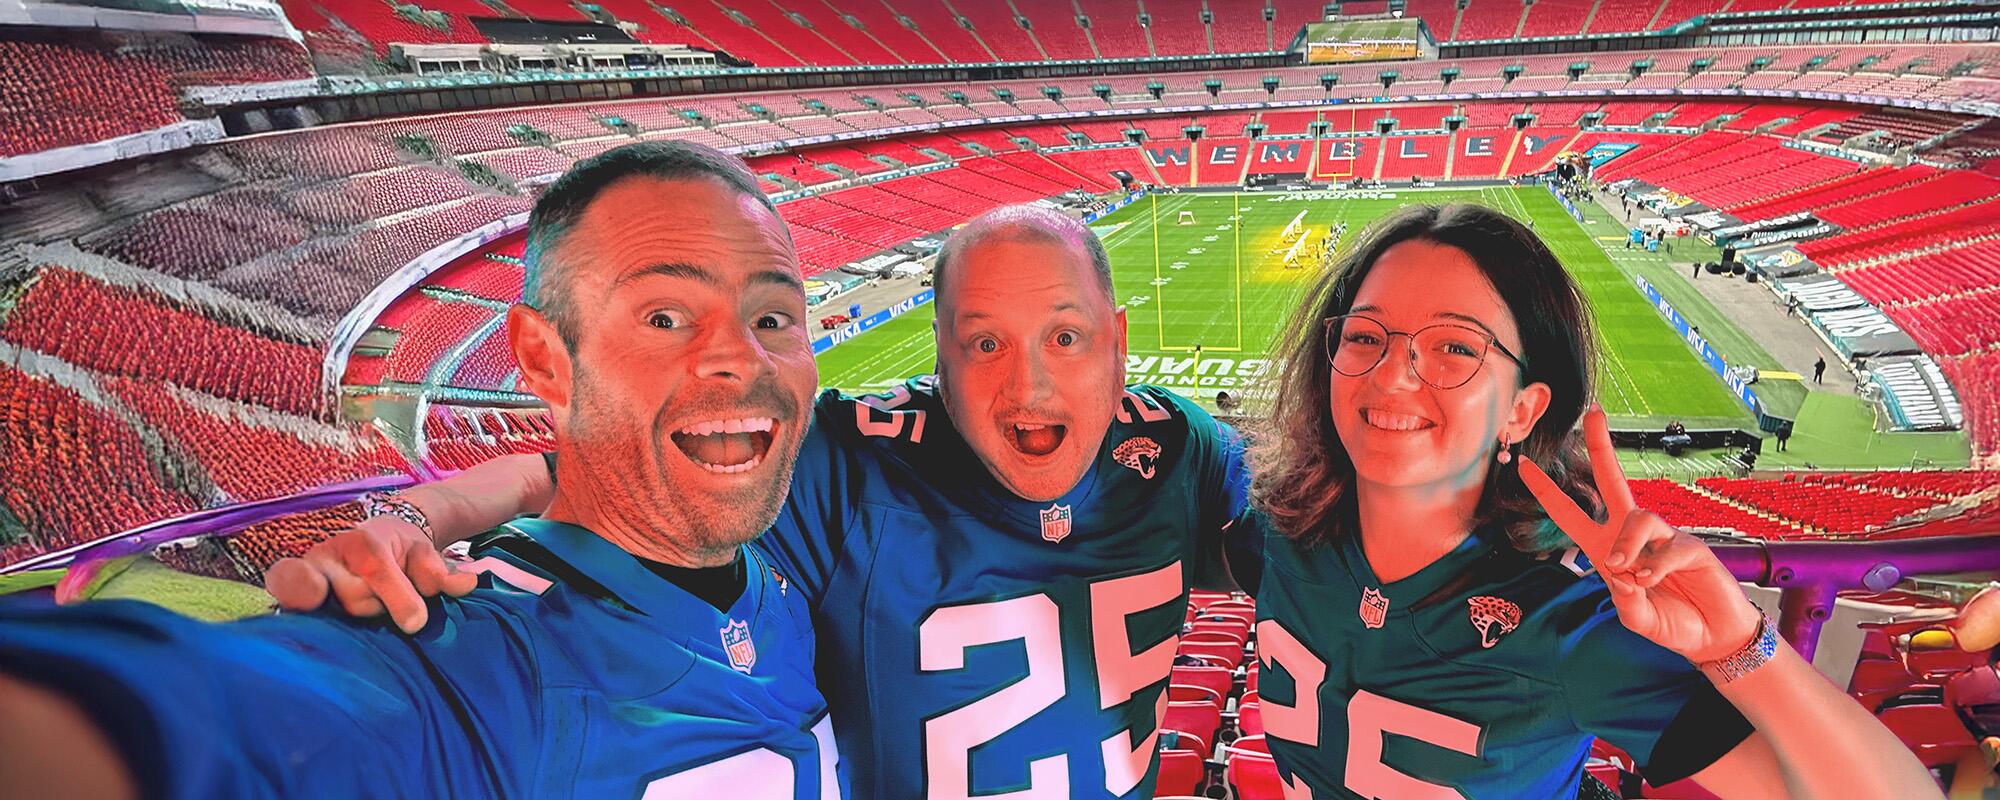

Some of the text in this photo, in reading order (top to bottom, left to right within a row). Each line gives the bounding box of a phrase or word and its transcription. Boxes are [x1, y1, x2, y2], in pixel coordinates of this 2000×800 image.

[1145, 133, 1568, 167] WEMBLEY
[888, 297, 915, 318] VISA
[829, 321, 861, 346] VISA
[1687, 325, 1705, 356] VISA
[1723, 364, 1745, 400] VISA
[1046, 520, 1069, 537] NFL
[1363, 601, 1382, 622] NFL
[731, 641, 752, 664] NFL
[919, 559, 1184, 800] 25
